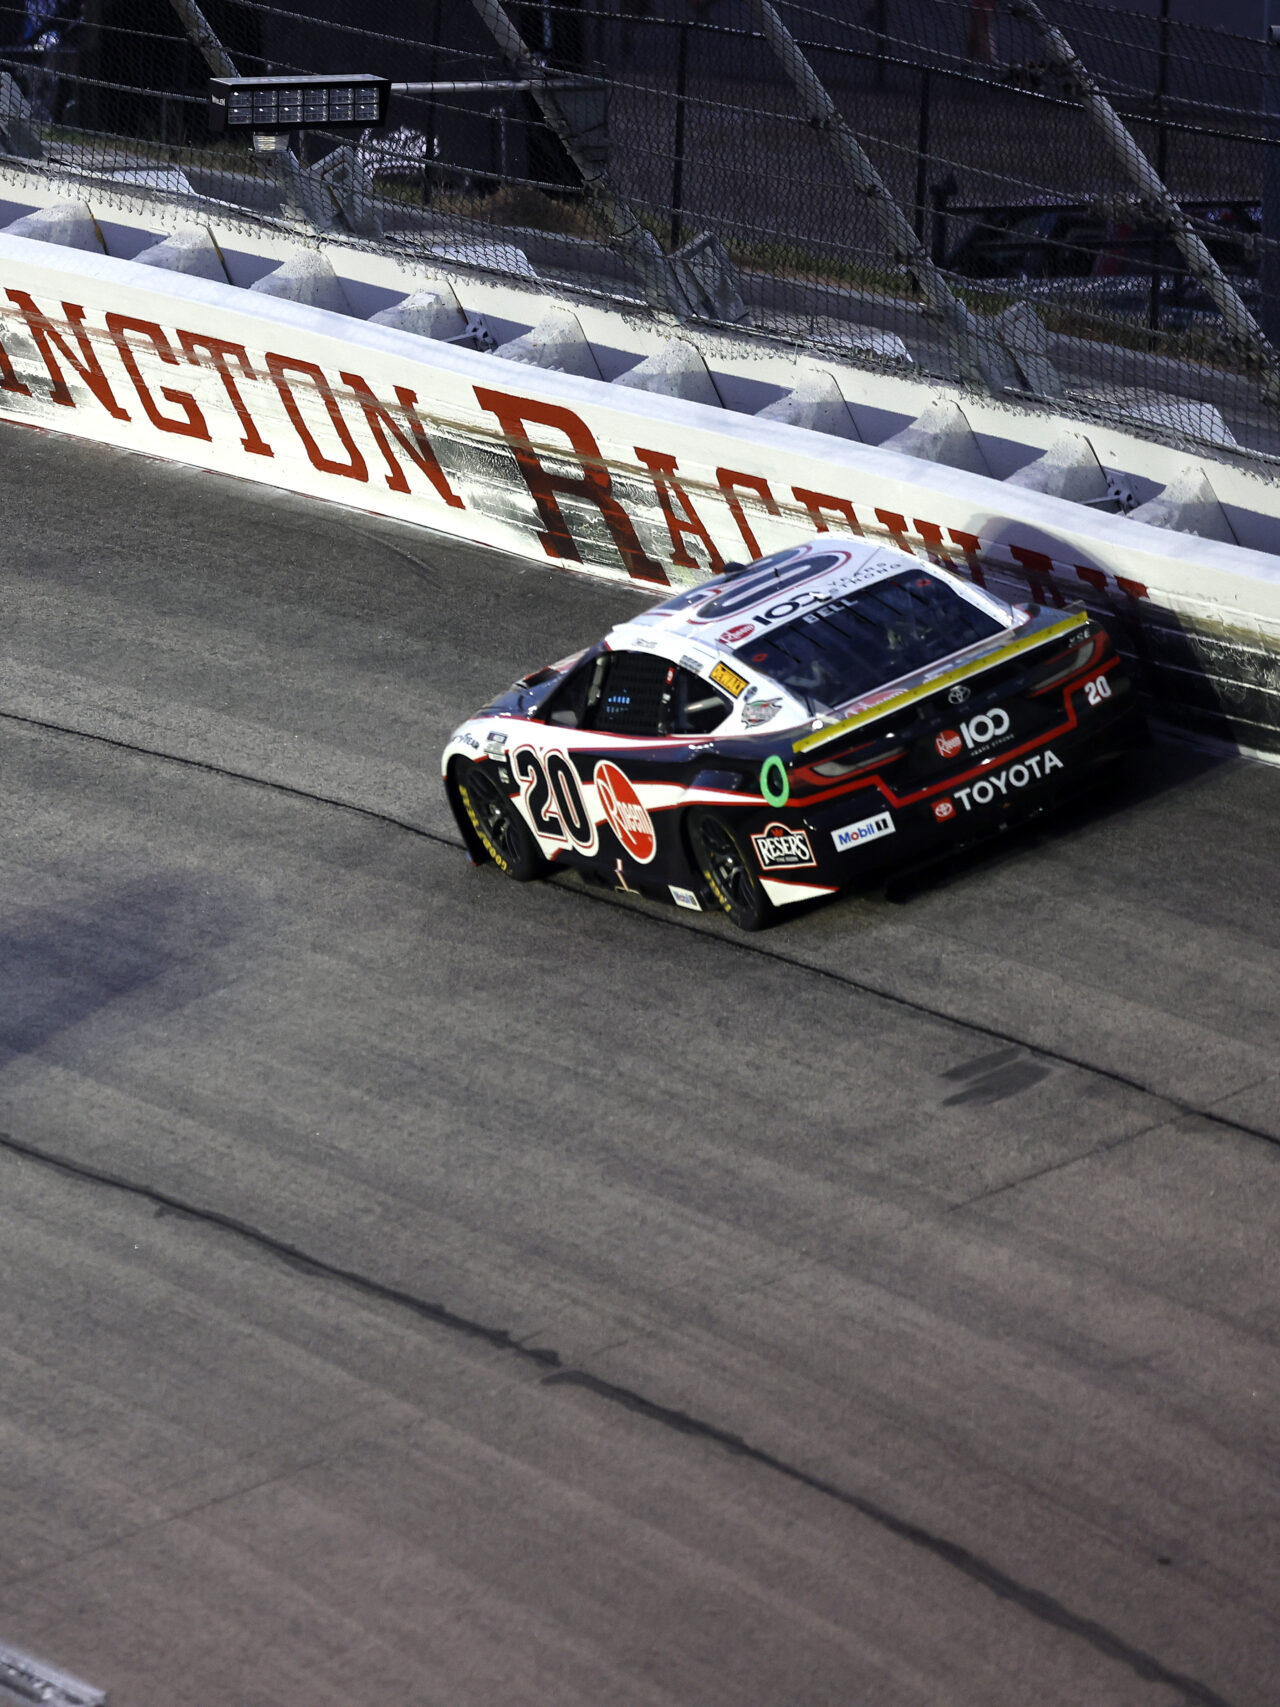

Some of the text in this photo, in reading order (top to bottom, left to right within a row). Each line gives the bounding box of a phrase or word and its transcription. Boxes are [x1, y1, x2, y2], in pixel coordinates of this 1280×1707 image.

[802, 599, 859, 625] BELL
[1084, 675, 1112, 706] 20
[451, 733, 480, 750] YEAR
[935, 707, 1010, 757] Rheem 100
[510, 743, 599, 857] 20
[953, 750, 1064, 811] TOYOTA
[596, 764, 654, 846] Rheem
[838, 823, 875, 846] Mobil
